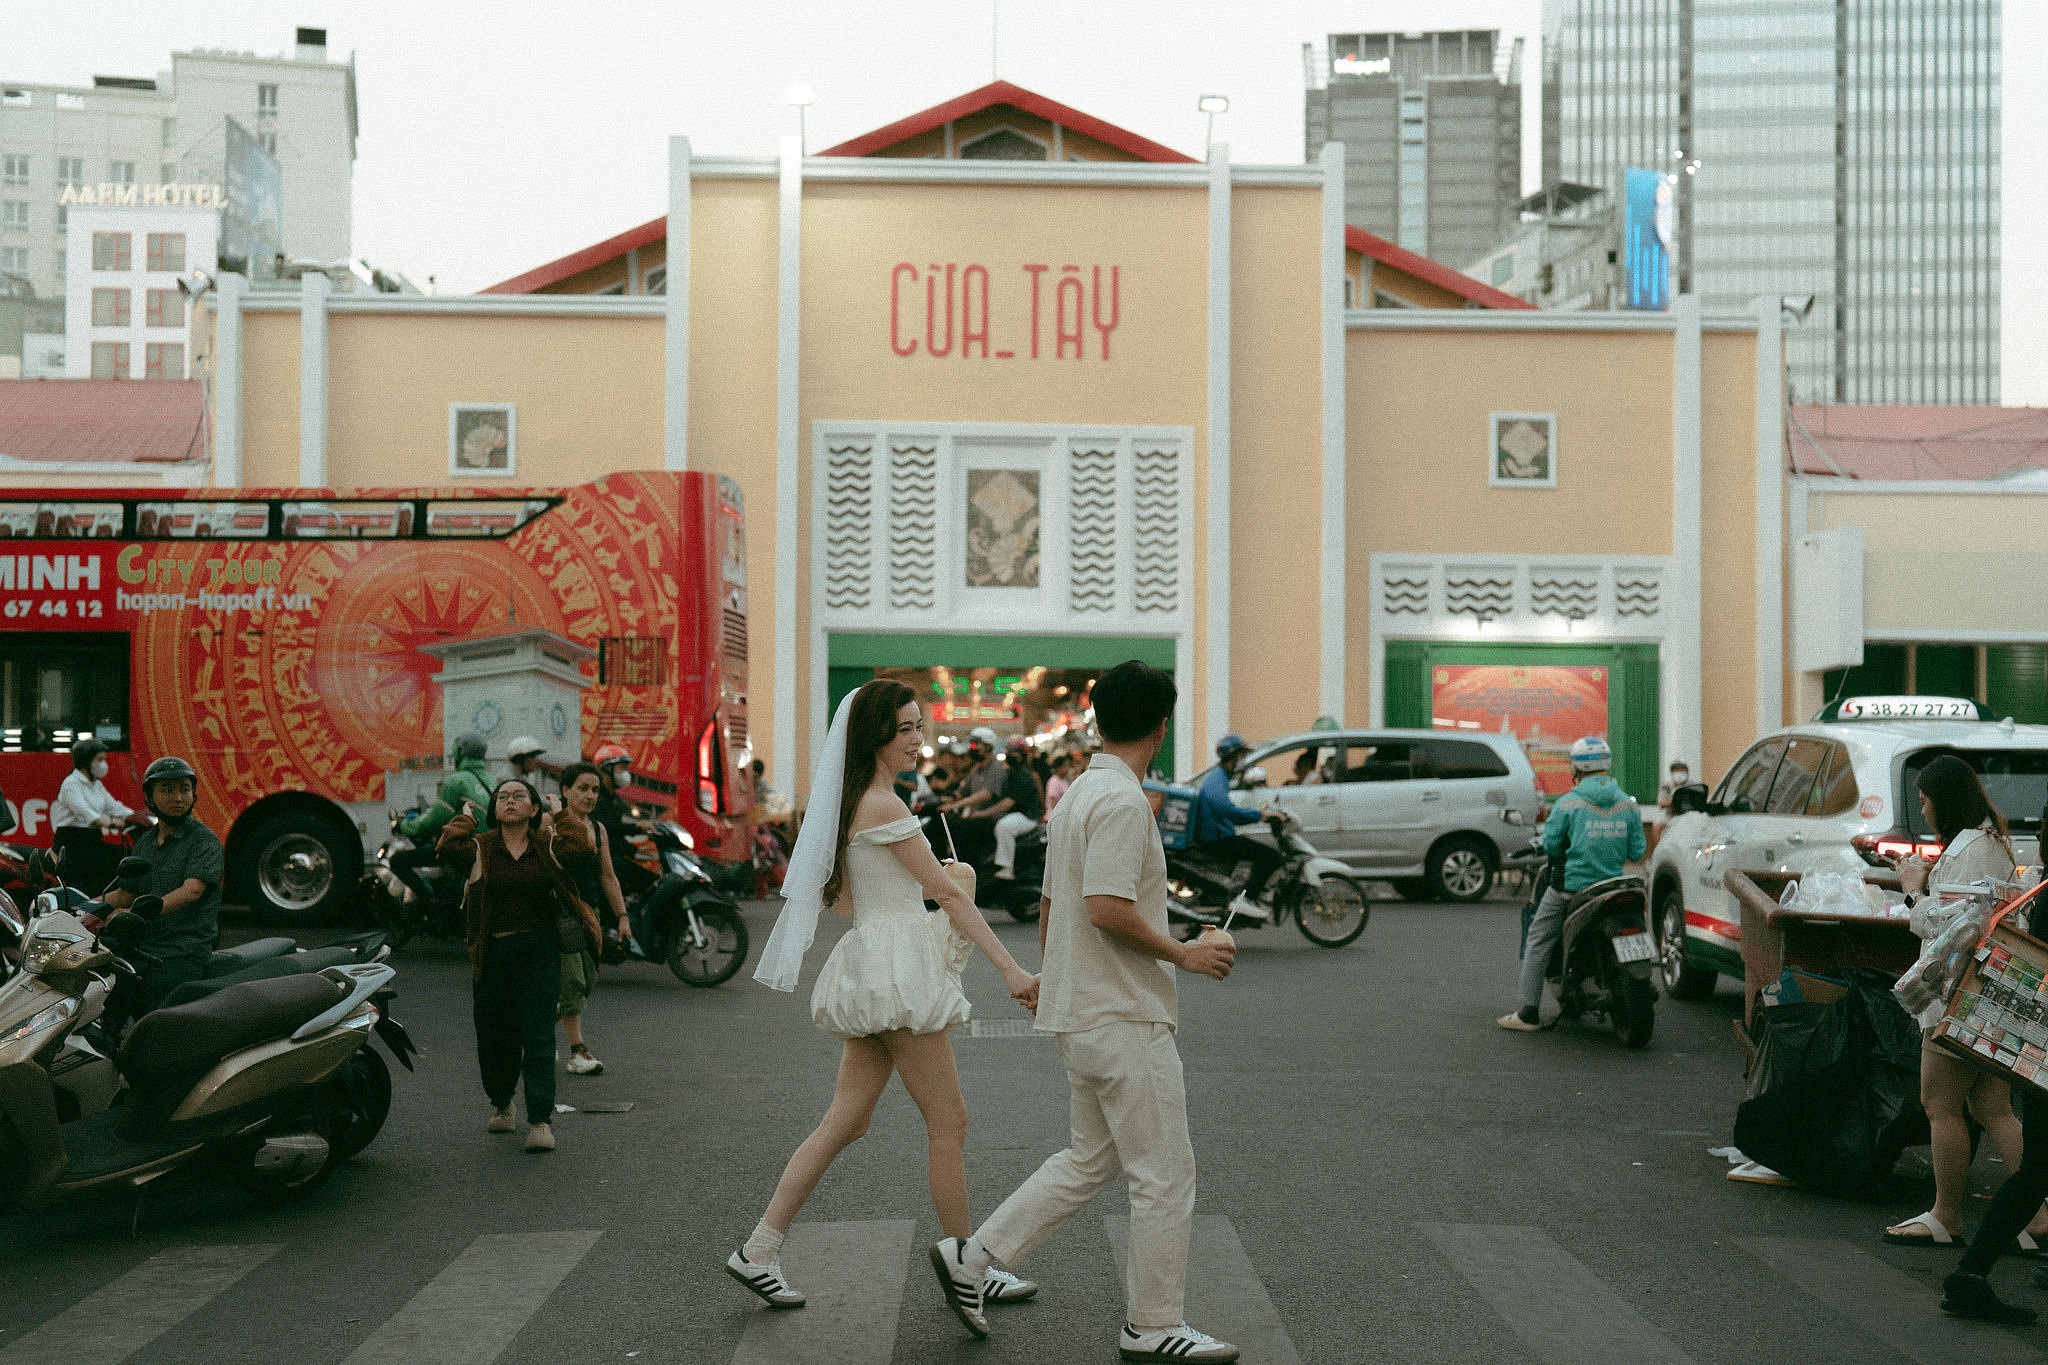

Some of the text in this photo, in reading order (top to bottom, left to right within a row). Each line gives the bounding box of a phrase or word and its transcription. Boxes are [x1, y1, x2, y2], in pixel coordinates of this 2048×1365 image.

[143, 183, 229, 209] HOTEL
[4, 600, 103, 617] 67 44 12
[116, 587, 312, 616] hopon-hopoff.vn
[1925, 704, 1944, 716] 27
[1950, 703, 1970, 716] 27
